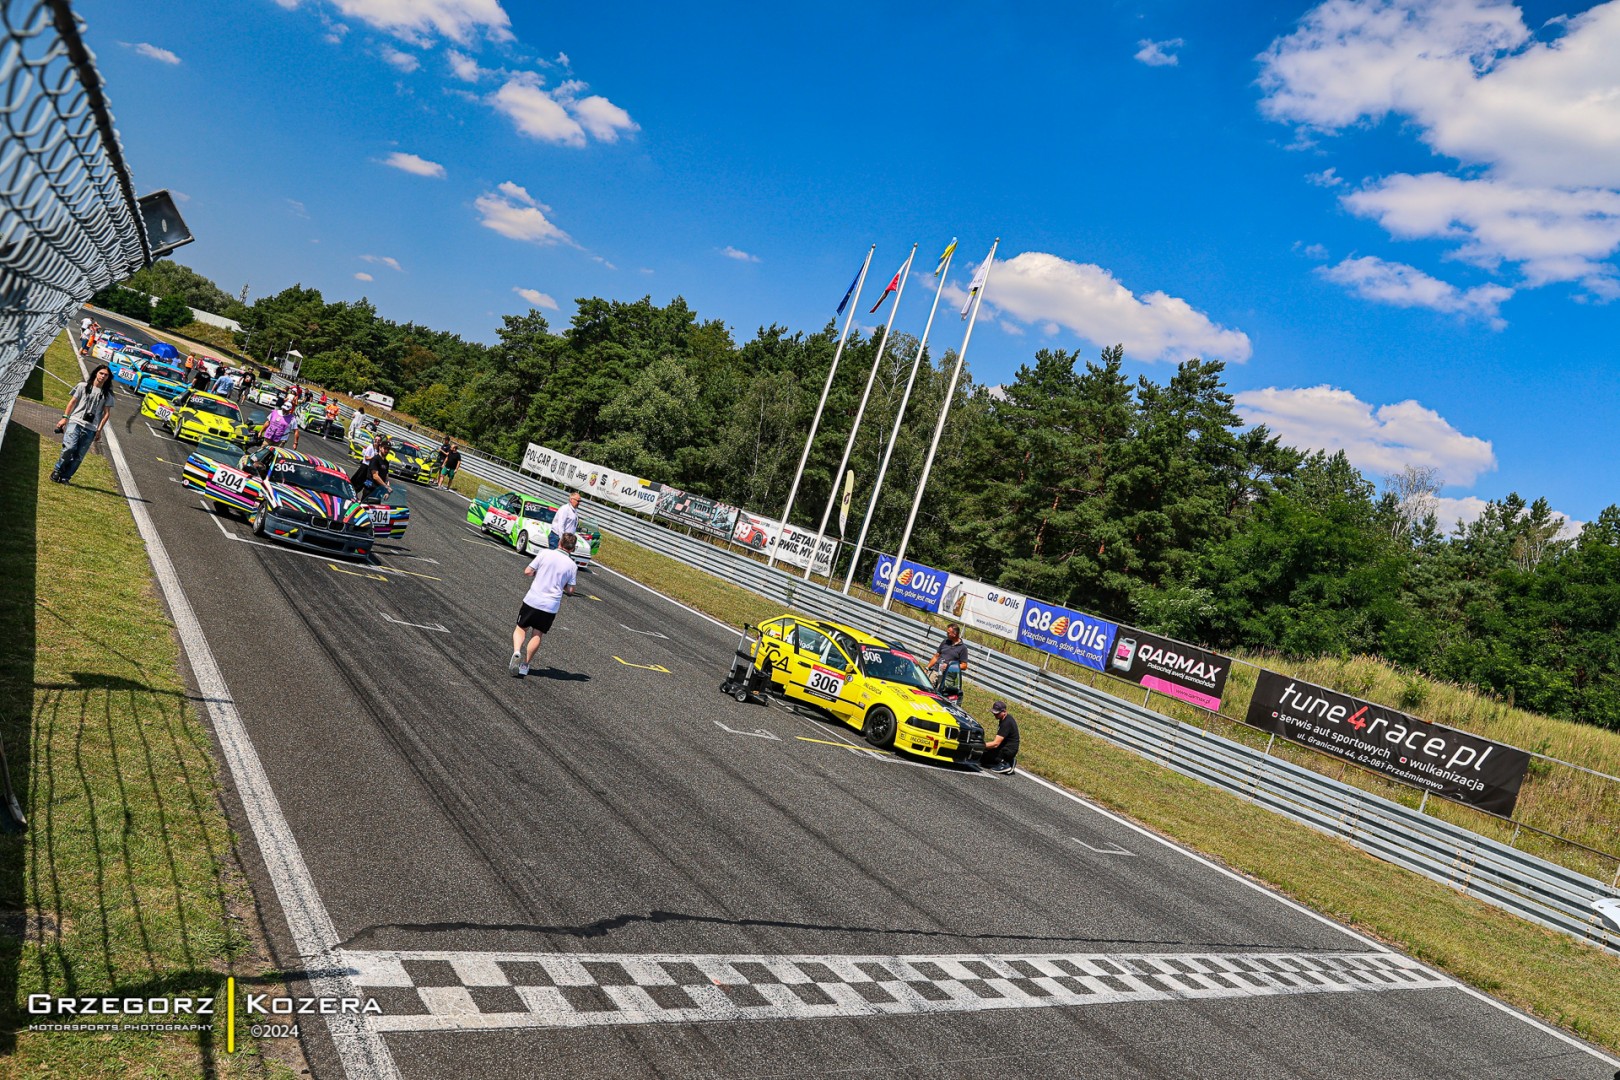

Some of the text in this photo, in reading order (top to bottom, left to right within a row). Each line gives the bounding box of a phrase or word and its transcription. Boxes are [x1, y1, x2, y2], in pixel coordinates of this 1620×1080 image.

[157, 407, 171, 419] 302
[525, 448, 551, 467] POL-CAR
[274, 463, 296, 473] 304
[576, 470, 588, 482] Jeep
[217, 470, 244, 490] 304
[637, 490, 656, 503] IVECO
[371, 509, 389, 523] 304
[525, 504, 537, 512] 312
[490, 515, 508, 529] 312
[768, 536, 800, 556] SRWIS,
[798, 547, 830, 565] MYNIA
[911, 571, 942, 596] Oils
[987, 591, 1020, 610] Q8 Oils
[1025, 607, 1108, 651] Q8 Oils
[1021, 628, 1047, 644] Wszędzie
[1058, 641, 1075, 654] gdzie
[1072, 645, 1088, 659] jest
[862, 650, 883, 664] 306
[1137, 644, 1223, 683] QARMAX
[1147, 662, 1173, 676] Pokochaj
[1171, 669, 1185, 680] swój
[811, 672, 839, 694] 306
[863, 682, 883, 696] INLOGICA
[1175, 688, 1212, 705] www.qarmax.pl
[1278, 682, 1494, 772] tune4race.pl
[909, 736, 931, 746] INLOGICA
[1279, 712, 1485, 792] serwis aut sportowych wulkanizacja
[1296, 732, 1443, 790] ul. Graniczna 44, 62-081 Przeźmierowo
